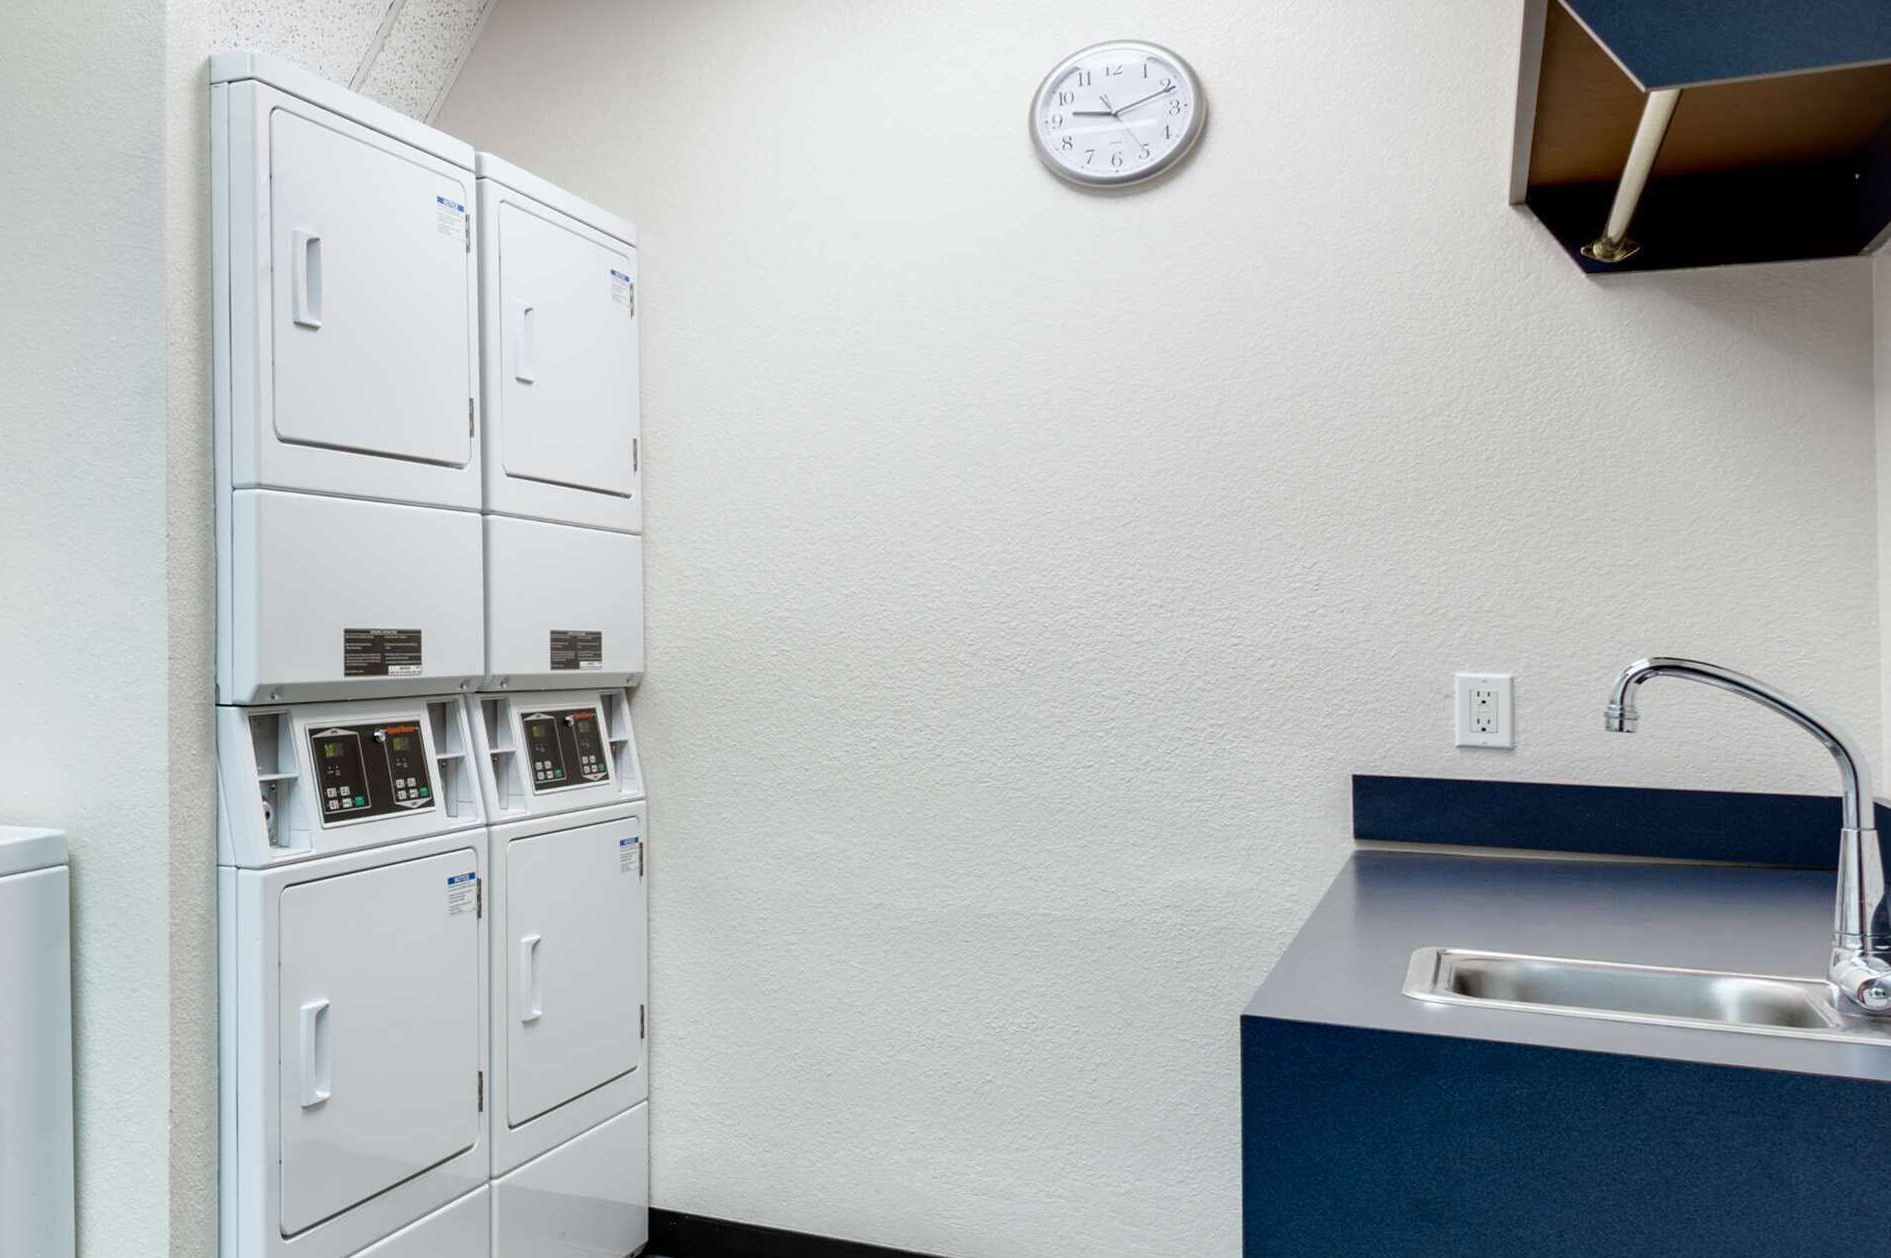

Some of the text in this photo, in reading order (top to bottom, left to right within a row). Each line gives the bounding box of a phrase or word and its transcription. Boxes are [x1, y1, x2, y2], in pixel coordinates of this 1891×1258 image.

[1078, 71, 1092, 86] 11
[1160, 78, 1172, 92] 2
[1059, 91, 1074, 106] 10
[1168, 99, 1180, 115] 3
[1051, 114, 1063, 129] 9
[1062, 135, 1073, 150] 8
[1084, 149, 1094, 164] 7
[1138, 143, 1150, 159] 5
[1111, 151, 1123, 167] 6
